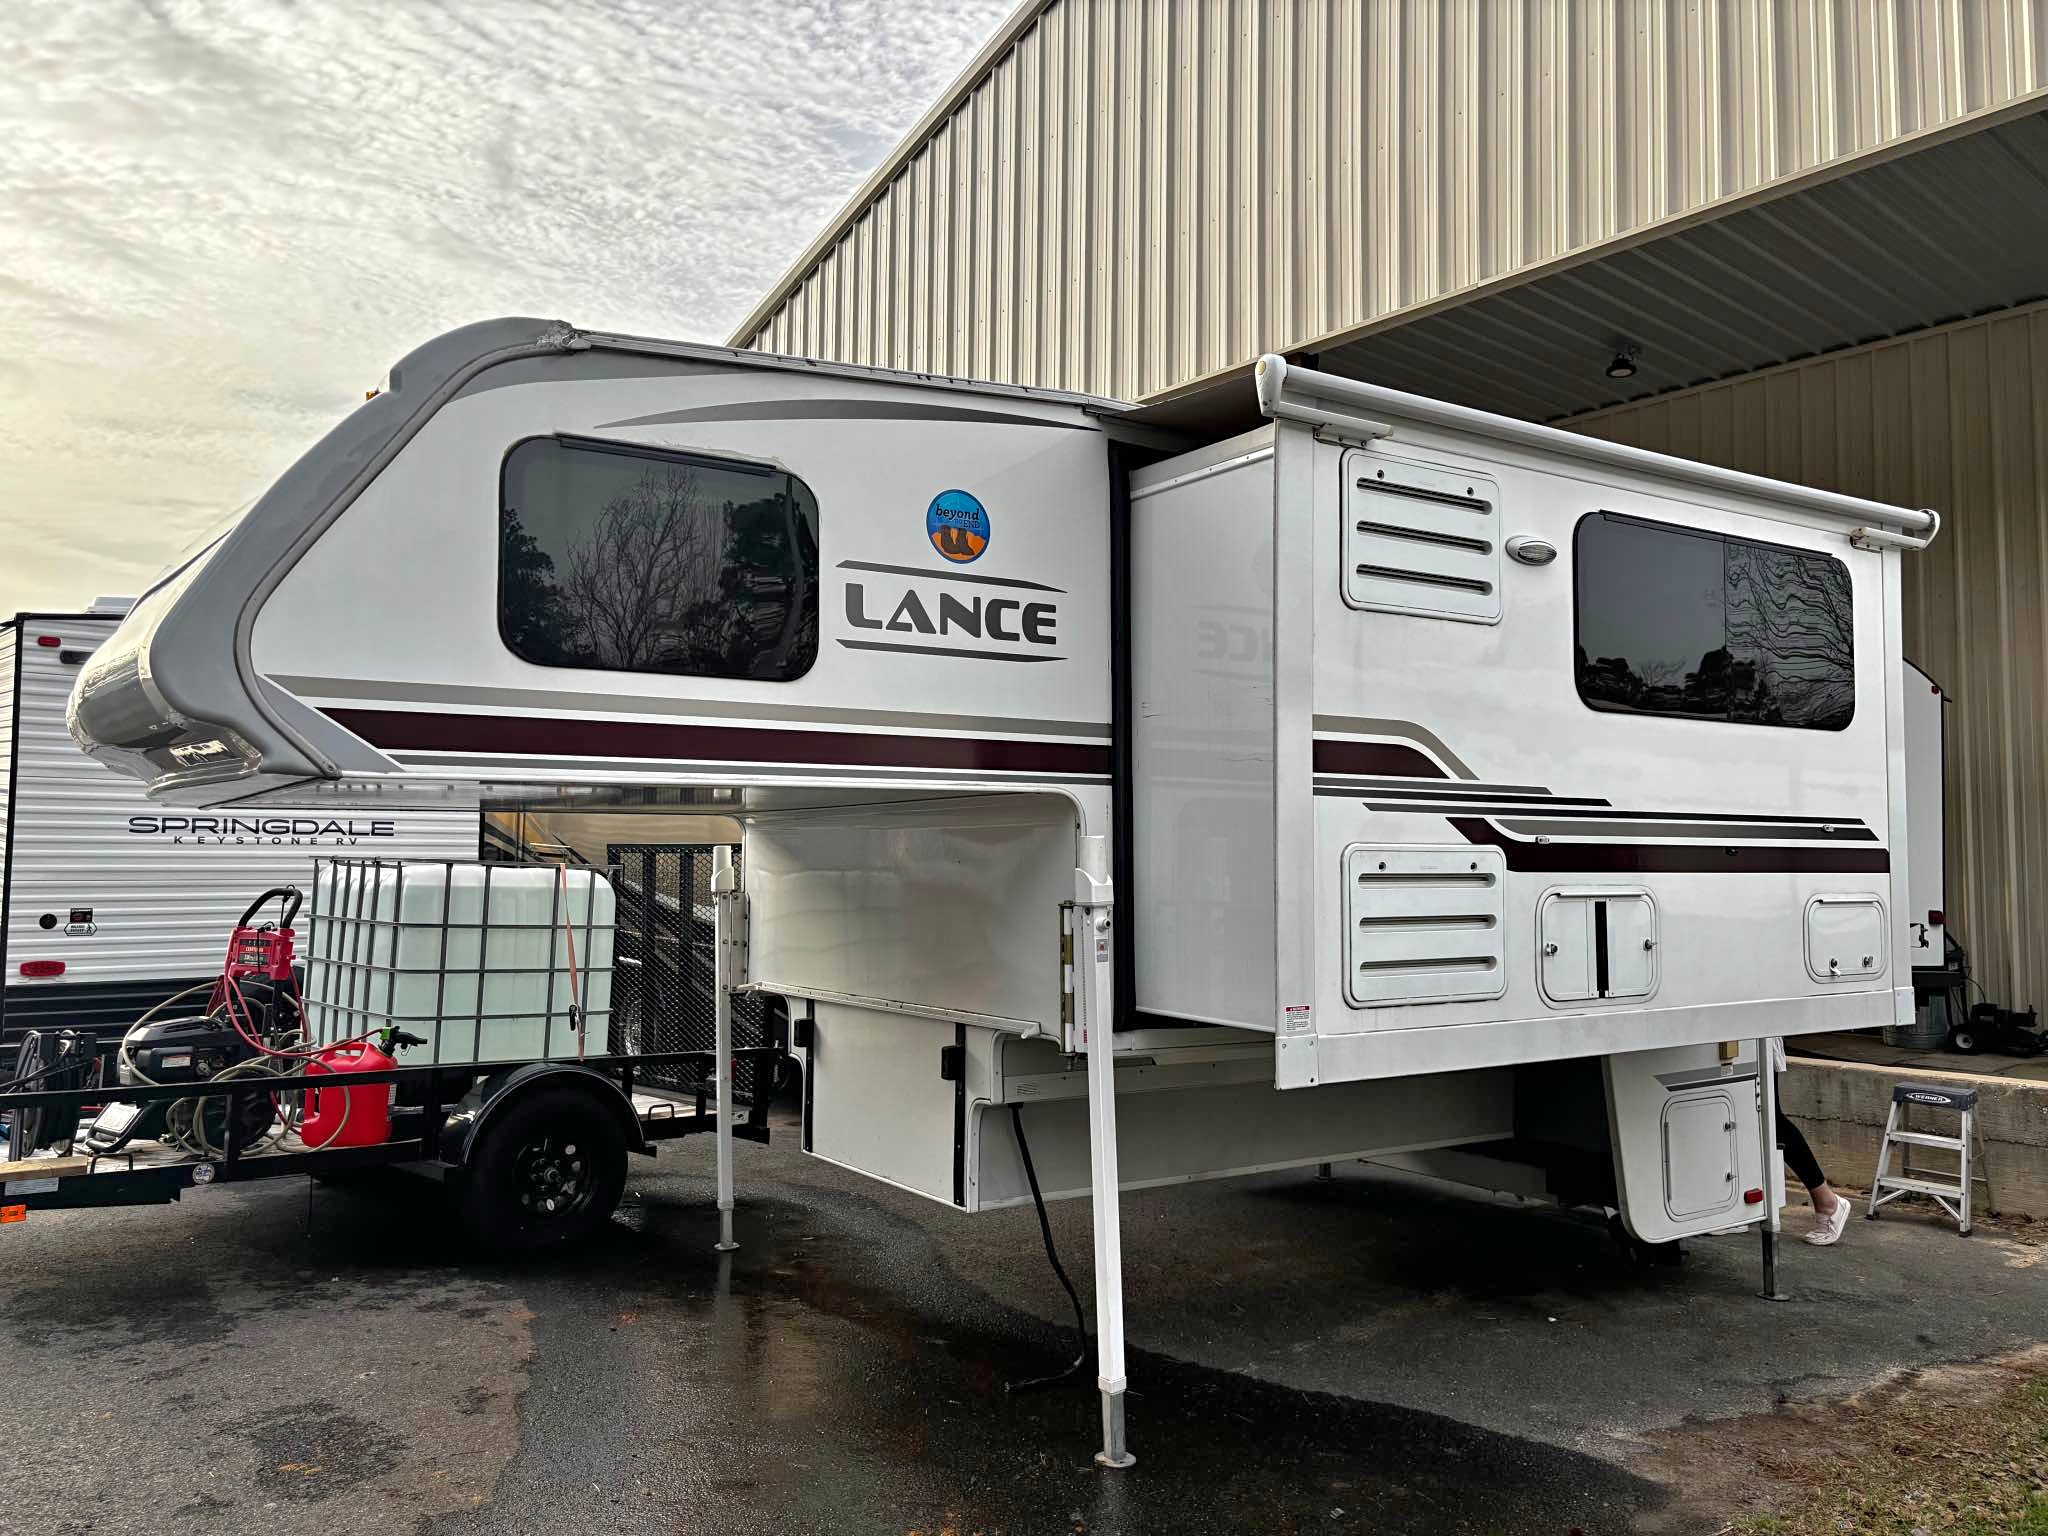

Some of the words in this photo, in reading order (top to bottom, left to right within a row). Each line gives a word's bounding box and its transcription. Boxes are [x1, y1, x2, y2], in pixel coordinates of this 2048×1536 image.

[936, 503, 980, 521] beyond
[845, 582, 1056, 645] LANCE
[128, 816, 395, 837] SPRINGDALE
[174, 835, 318, 846] KEYSTONE
[336, 837, 358, 846] RV
